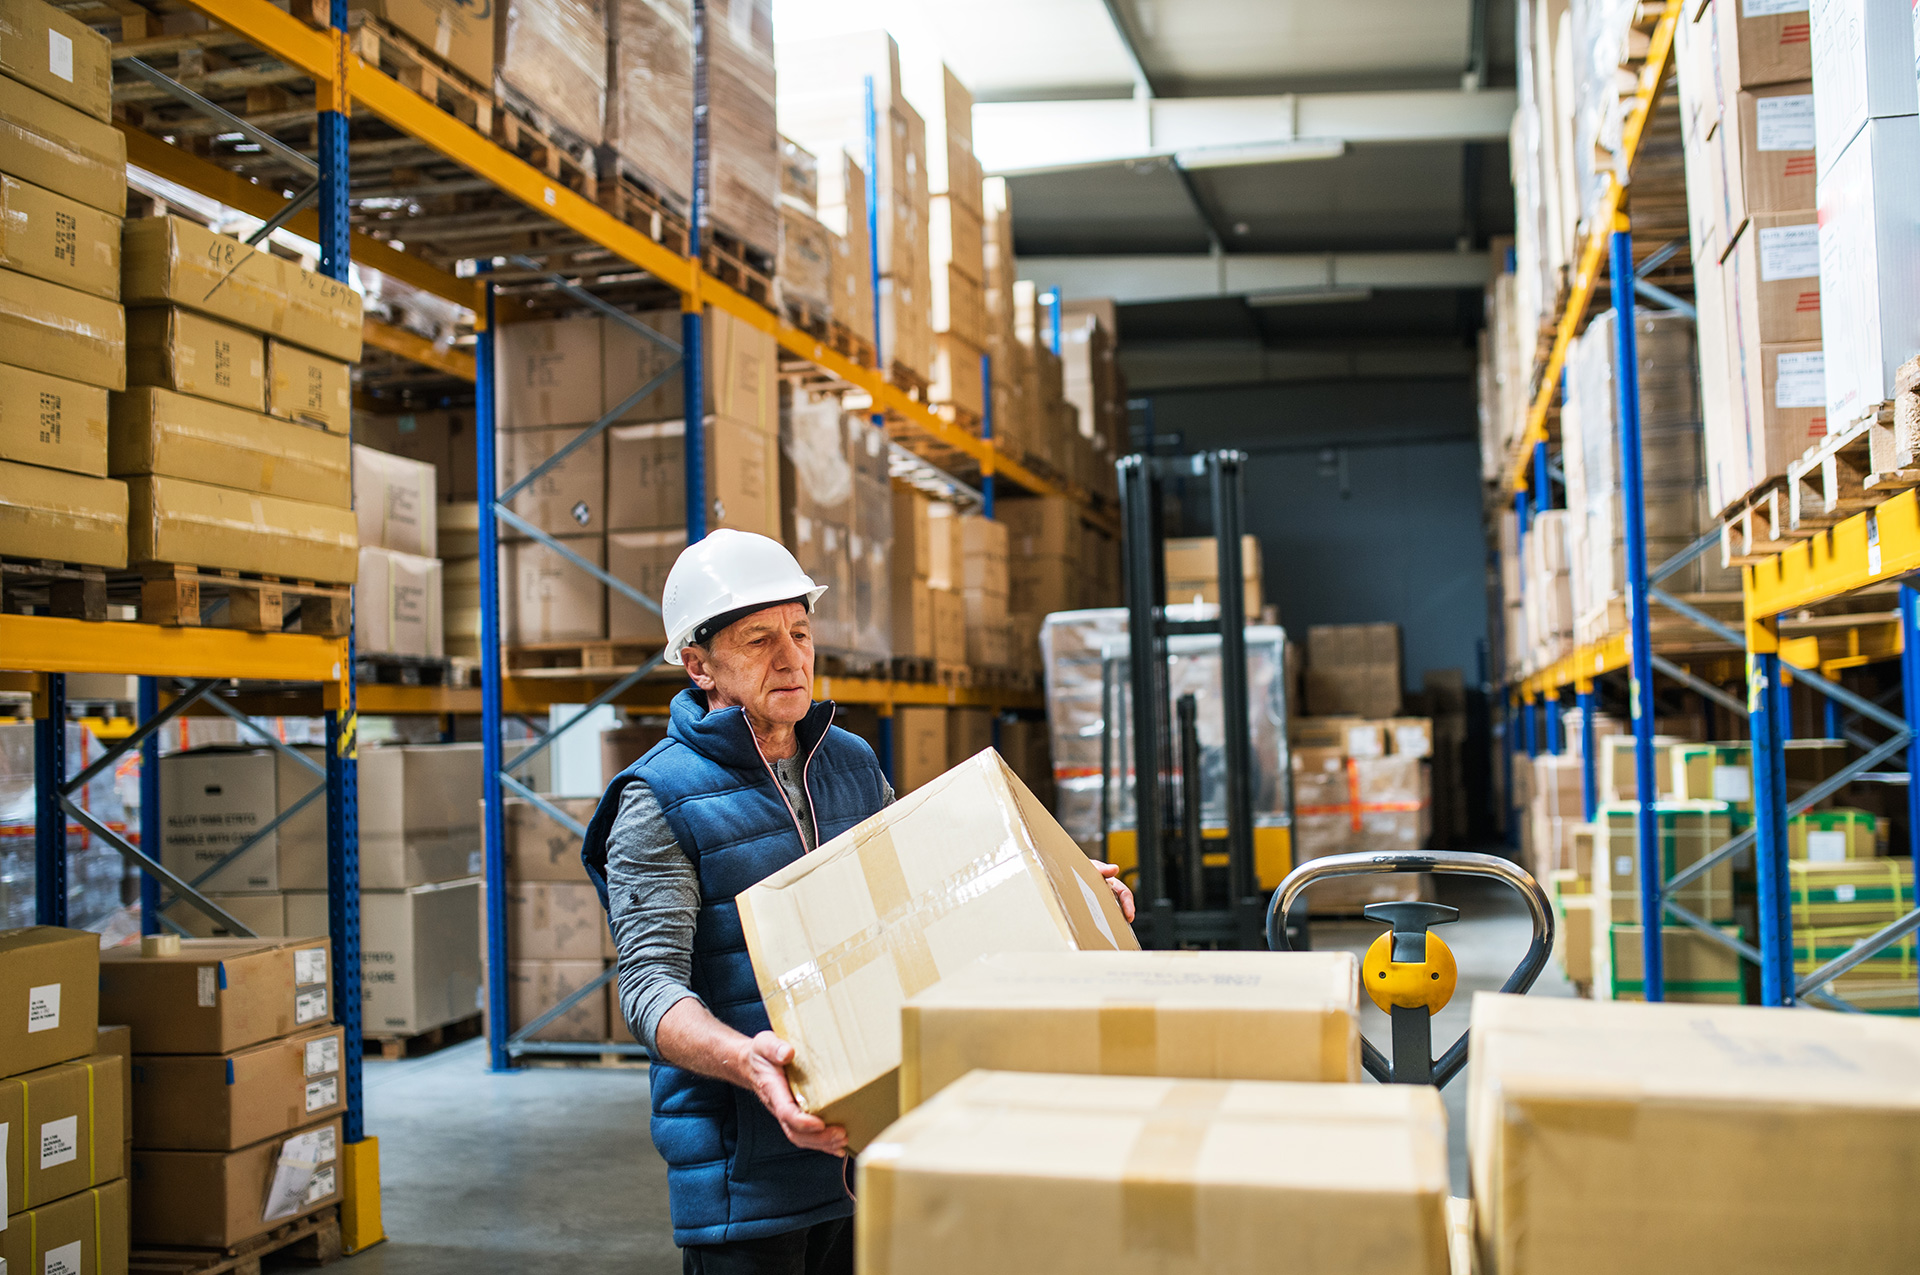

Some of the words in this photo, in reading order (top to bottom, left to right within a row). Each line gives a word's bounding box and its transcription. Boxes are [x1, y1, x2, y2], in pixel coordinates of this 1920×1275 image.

[167, 814, 197, 828] ALLOY
[166, 833, 204, 846] HANDLE
[205, 832, 230, 845] WITH
[367, 970, 396, 984] CARE
[44, 1139, 61, 1147] SLOVAKIA
[47, 1265, 66, 1274] SLOVAKIA
